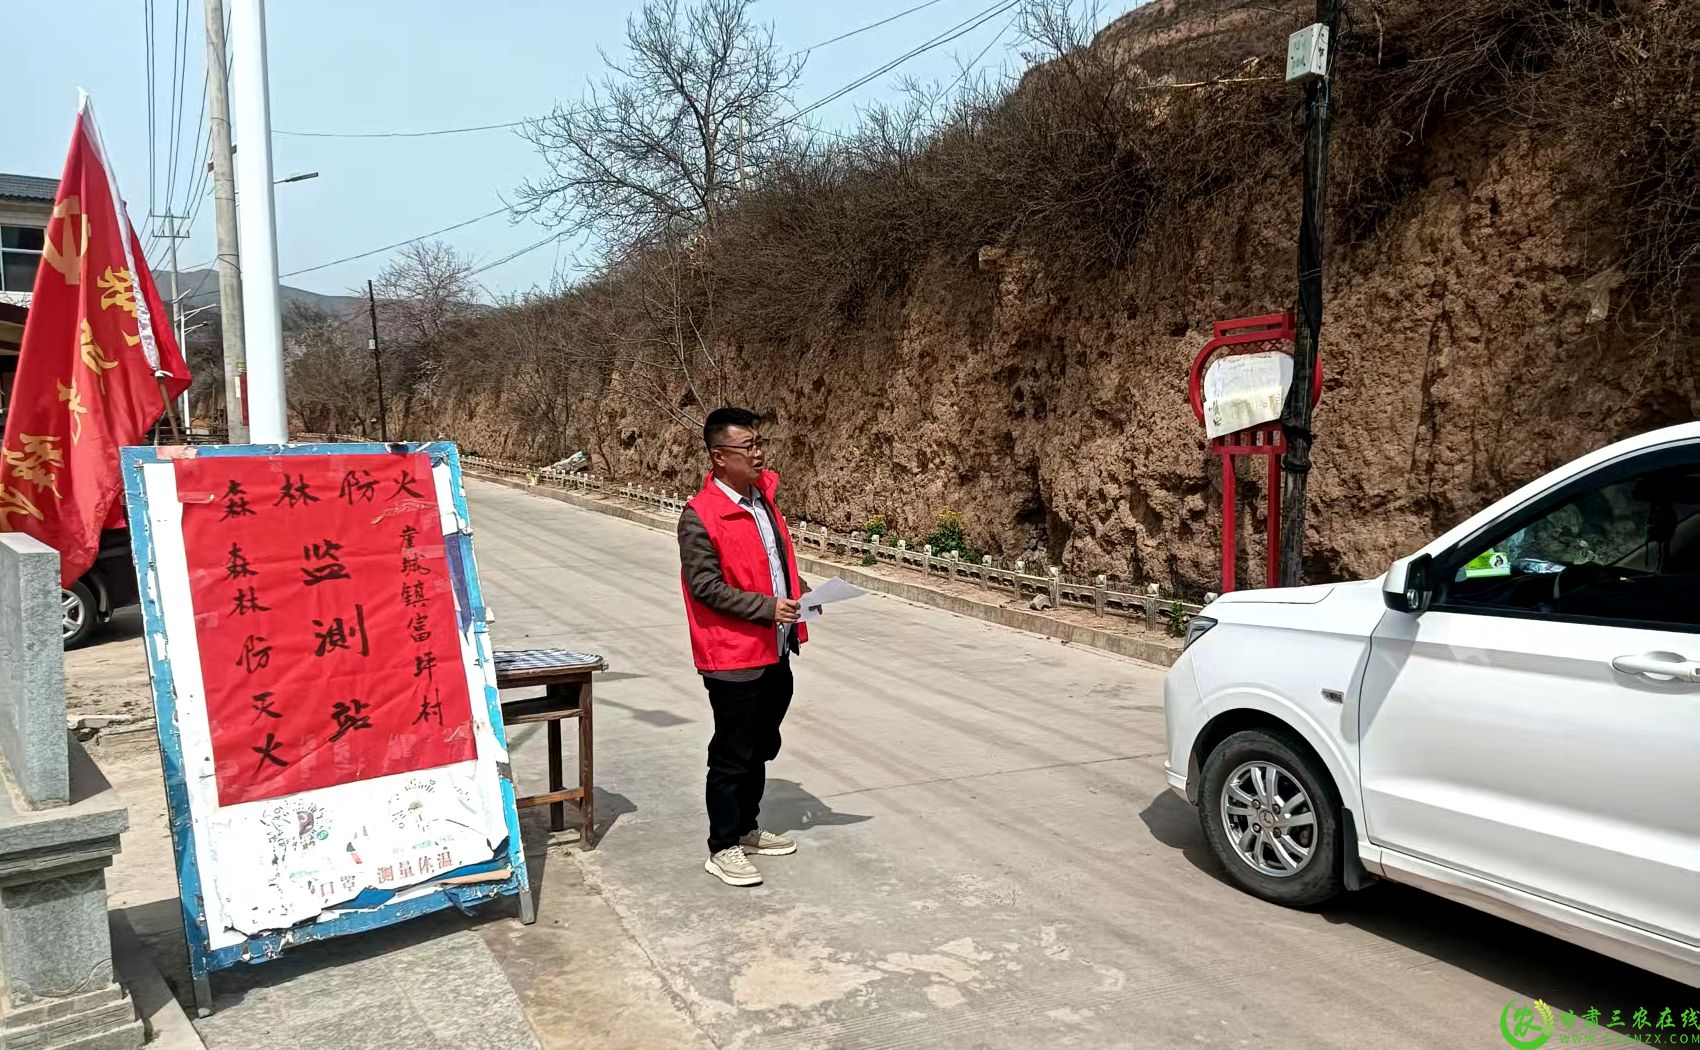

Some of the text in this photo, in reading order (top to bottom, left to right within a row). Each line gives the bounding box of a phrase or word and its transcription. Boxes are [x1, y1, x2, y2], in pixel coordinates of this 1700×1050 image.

[221, 471, 424, 521] 森林防火
[222, 542, 289, 777] 森林防灭火
[300, 539, 372, 742] 监测站
[307, 876, 356, 897] 口罩
